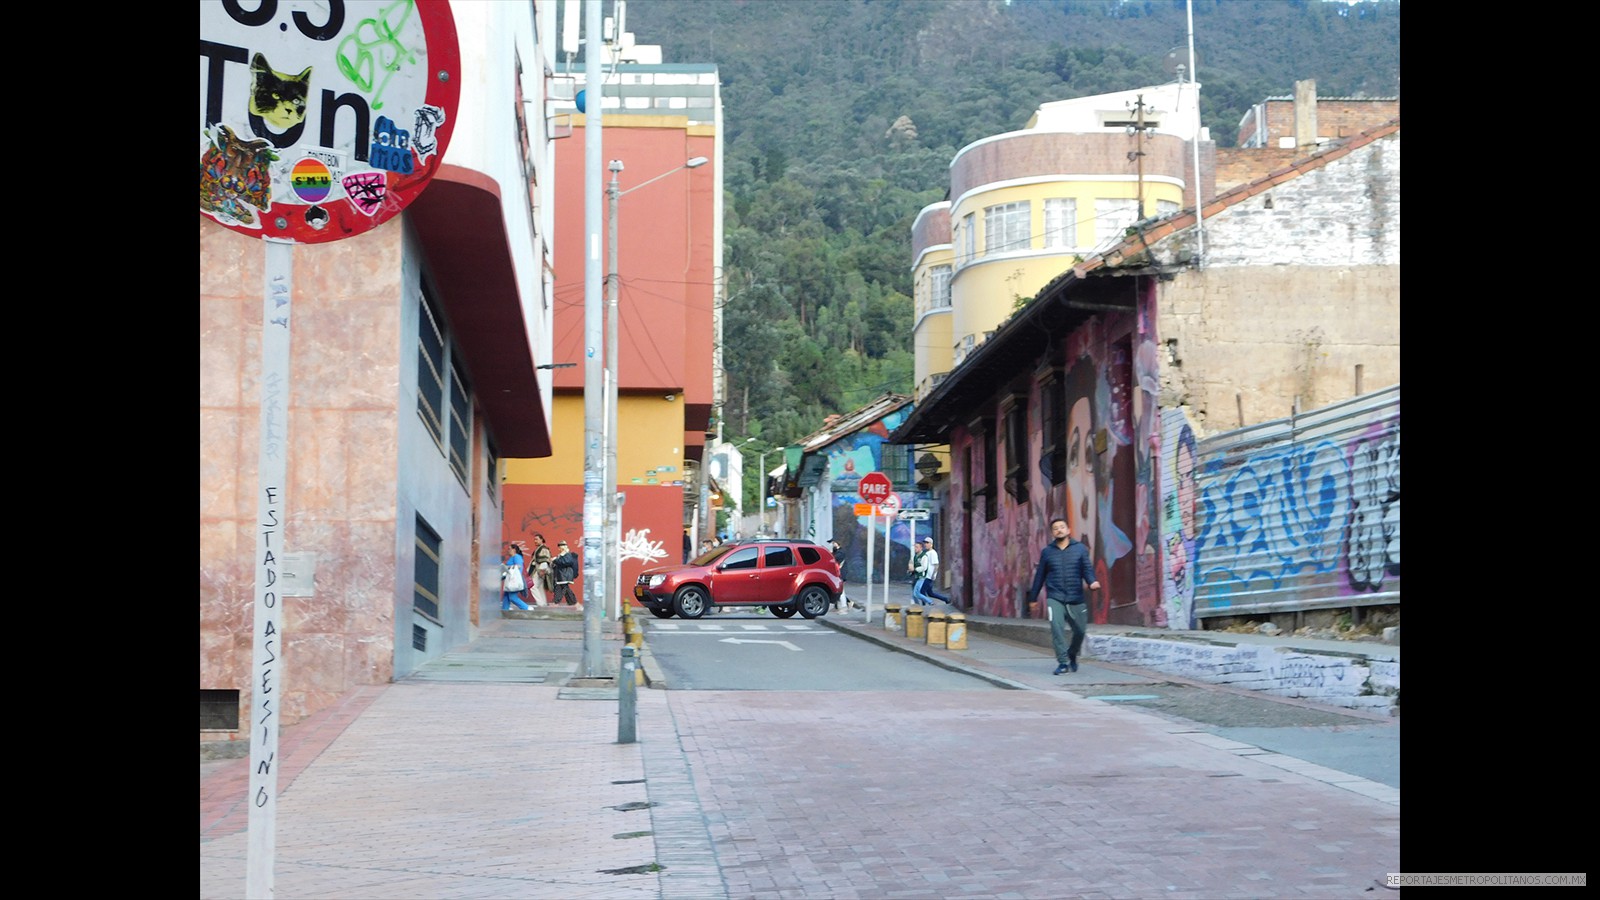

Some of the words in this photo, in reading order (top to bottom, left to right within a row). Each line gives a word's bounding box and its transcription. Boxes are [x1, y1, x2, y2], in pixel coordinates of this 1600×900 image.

[262, 487, 278, 608] ESTADO
[862, 483, 887, 495] PARE
[255, 620, 276, 807] ASESINO
